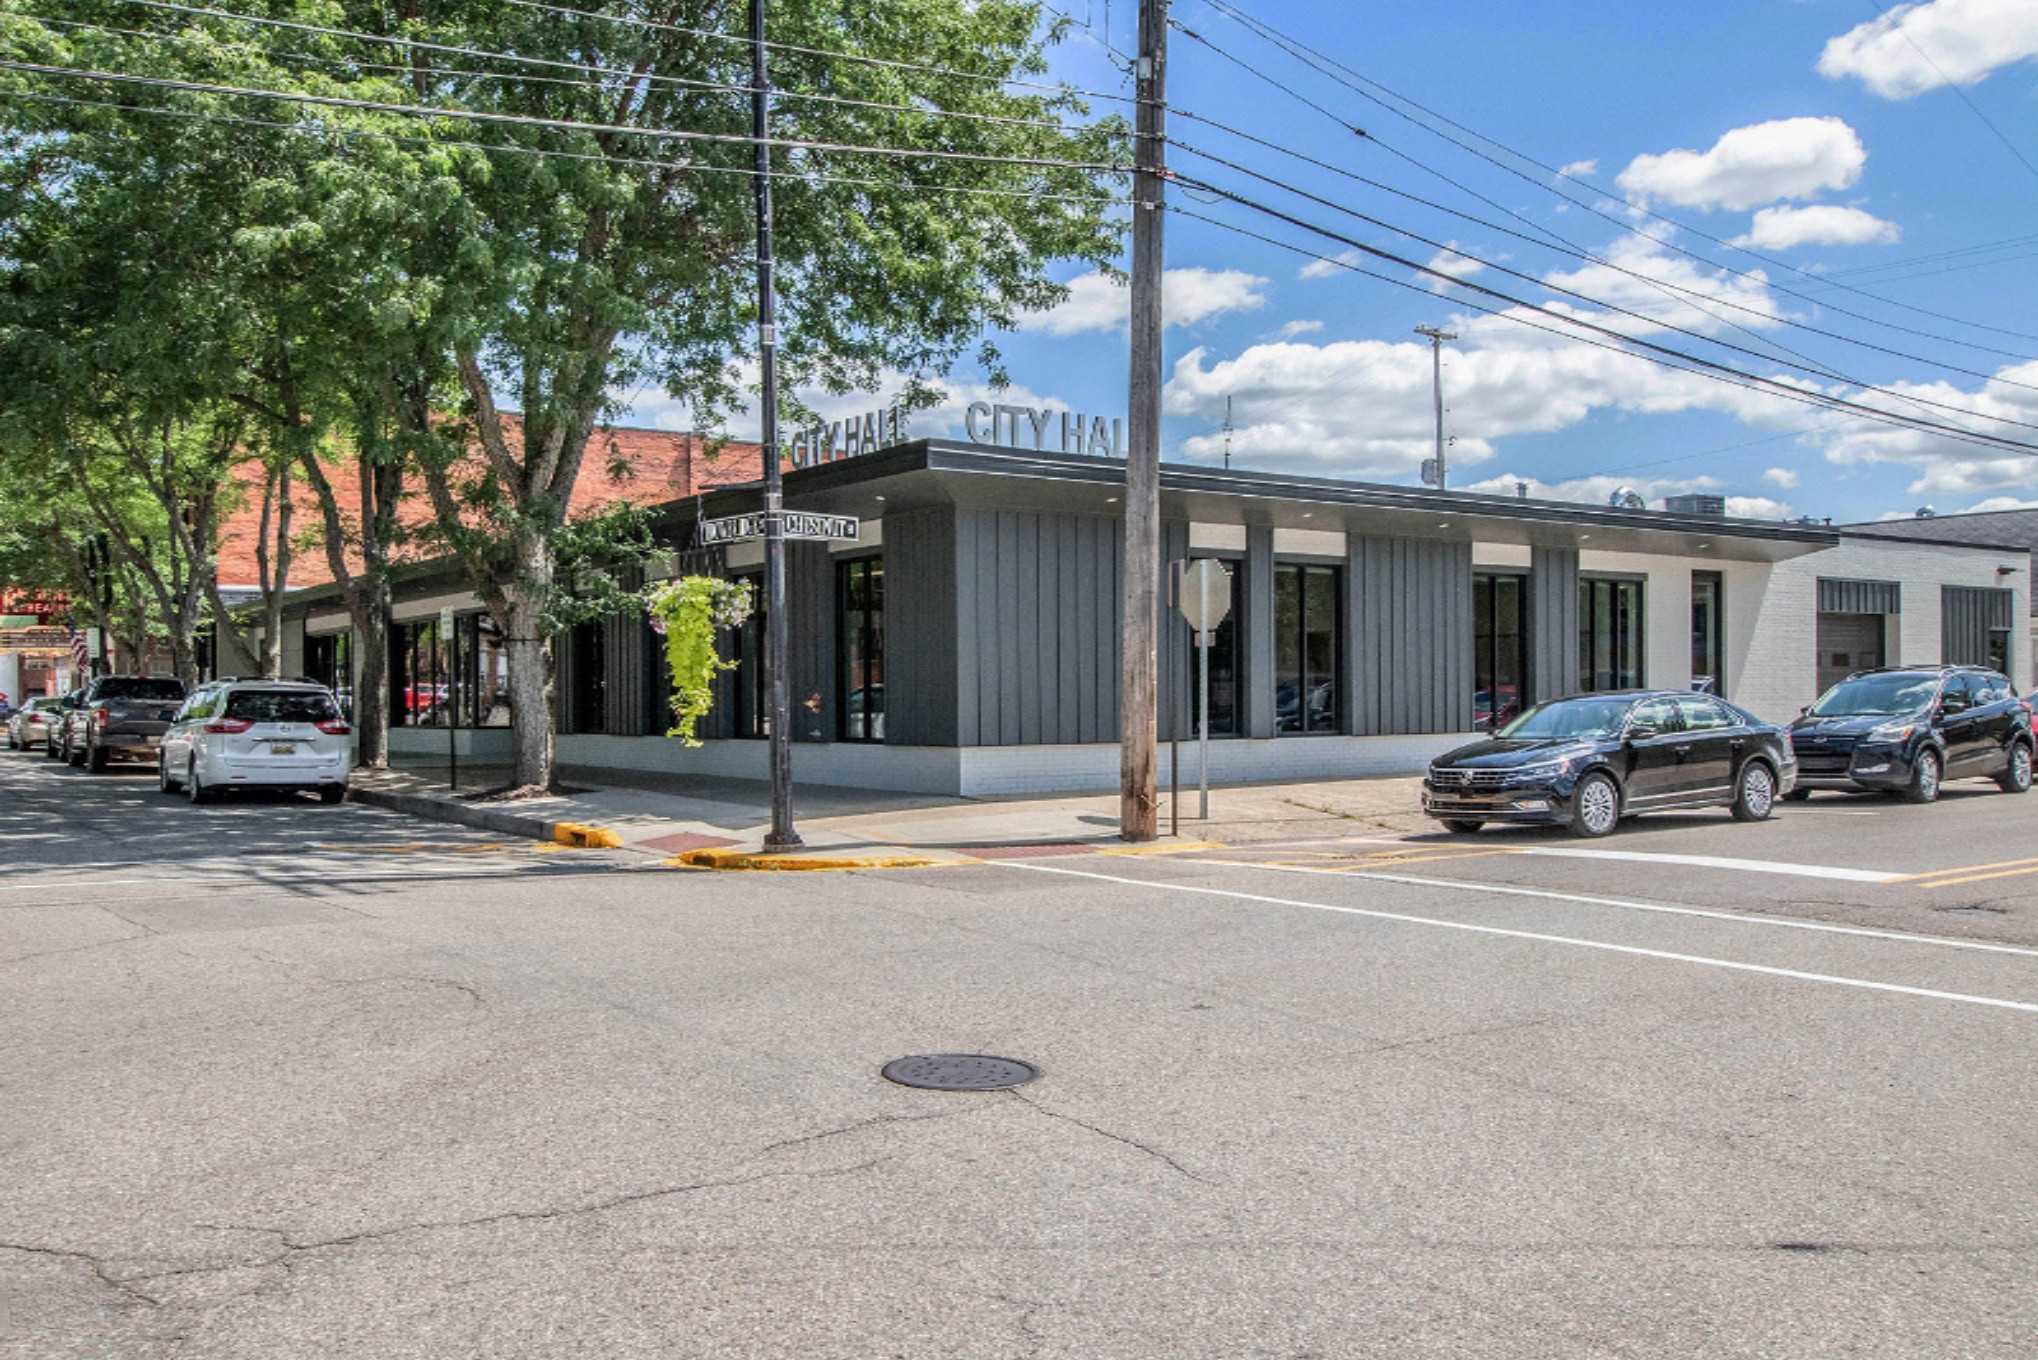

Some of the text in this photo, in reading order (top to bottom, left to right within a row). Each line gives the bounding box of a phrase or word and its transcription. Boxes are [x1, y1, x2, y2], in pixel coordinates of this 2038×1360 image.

[792, 406, 910, 469] CITY HALL
[966, 401, 1129, 459] CITY HAL
